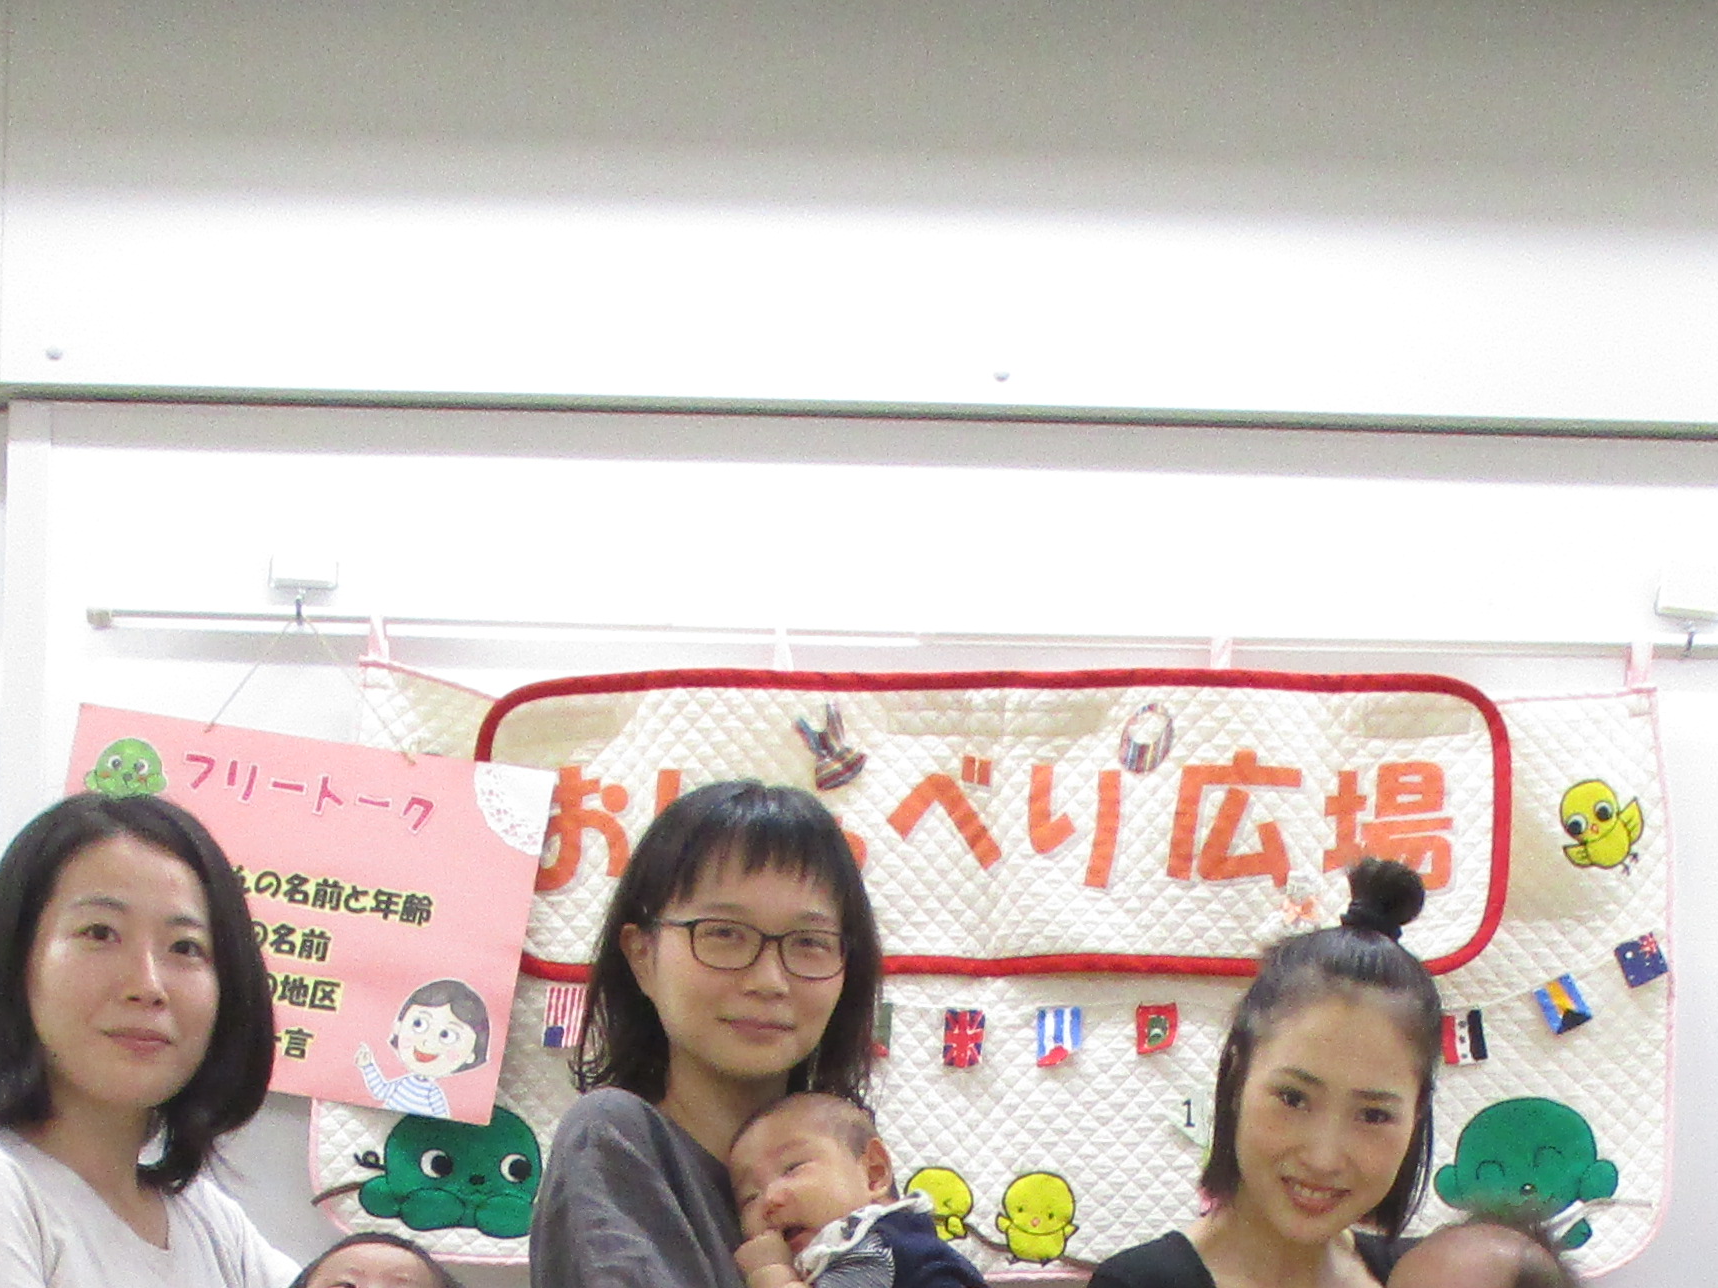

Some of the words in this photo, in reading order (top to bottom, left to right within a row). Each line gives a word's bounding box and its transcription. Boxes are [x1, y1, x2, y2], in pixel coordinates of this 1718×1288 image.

[183, 753, 435, 832] フリートーク
[535, 749, 1454, 891] おべり広場
